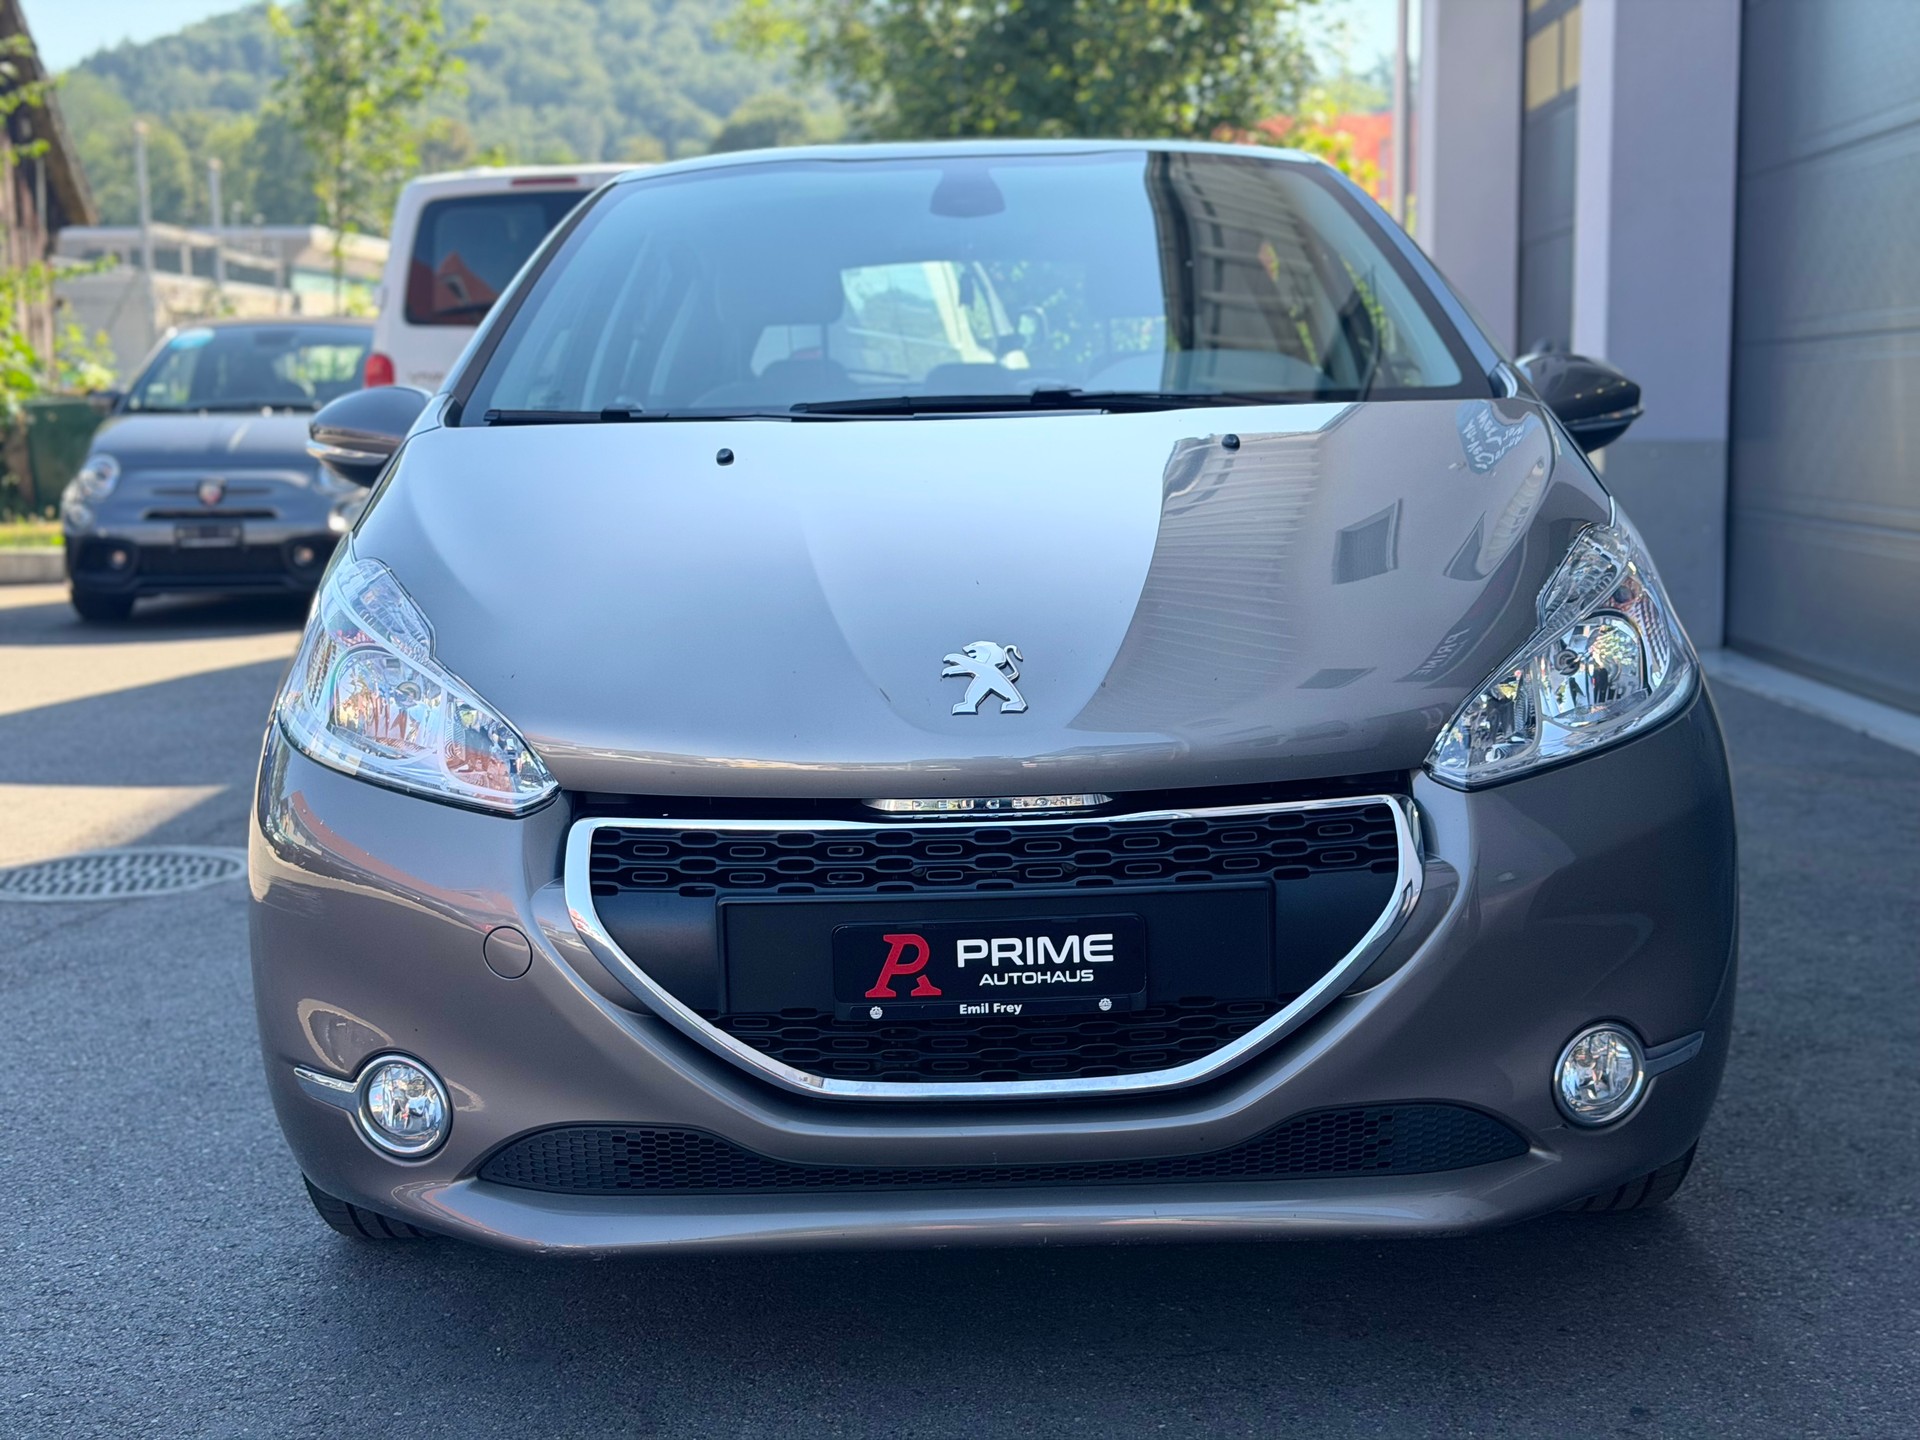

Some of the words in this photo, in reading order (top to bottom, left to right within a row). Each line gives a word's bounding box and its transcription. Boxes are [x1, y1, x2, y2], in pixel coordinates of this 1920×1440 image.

[912, 796, 1073, 810] PEUGEOT
[956, 934, 1114, 967] PRIME
[979, 969, 1094, 986] AUTOHAUS
[959, 1002, 989, 1015] Emil
[993, 1002, 1023, 1015] Frey
